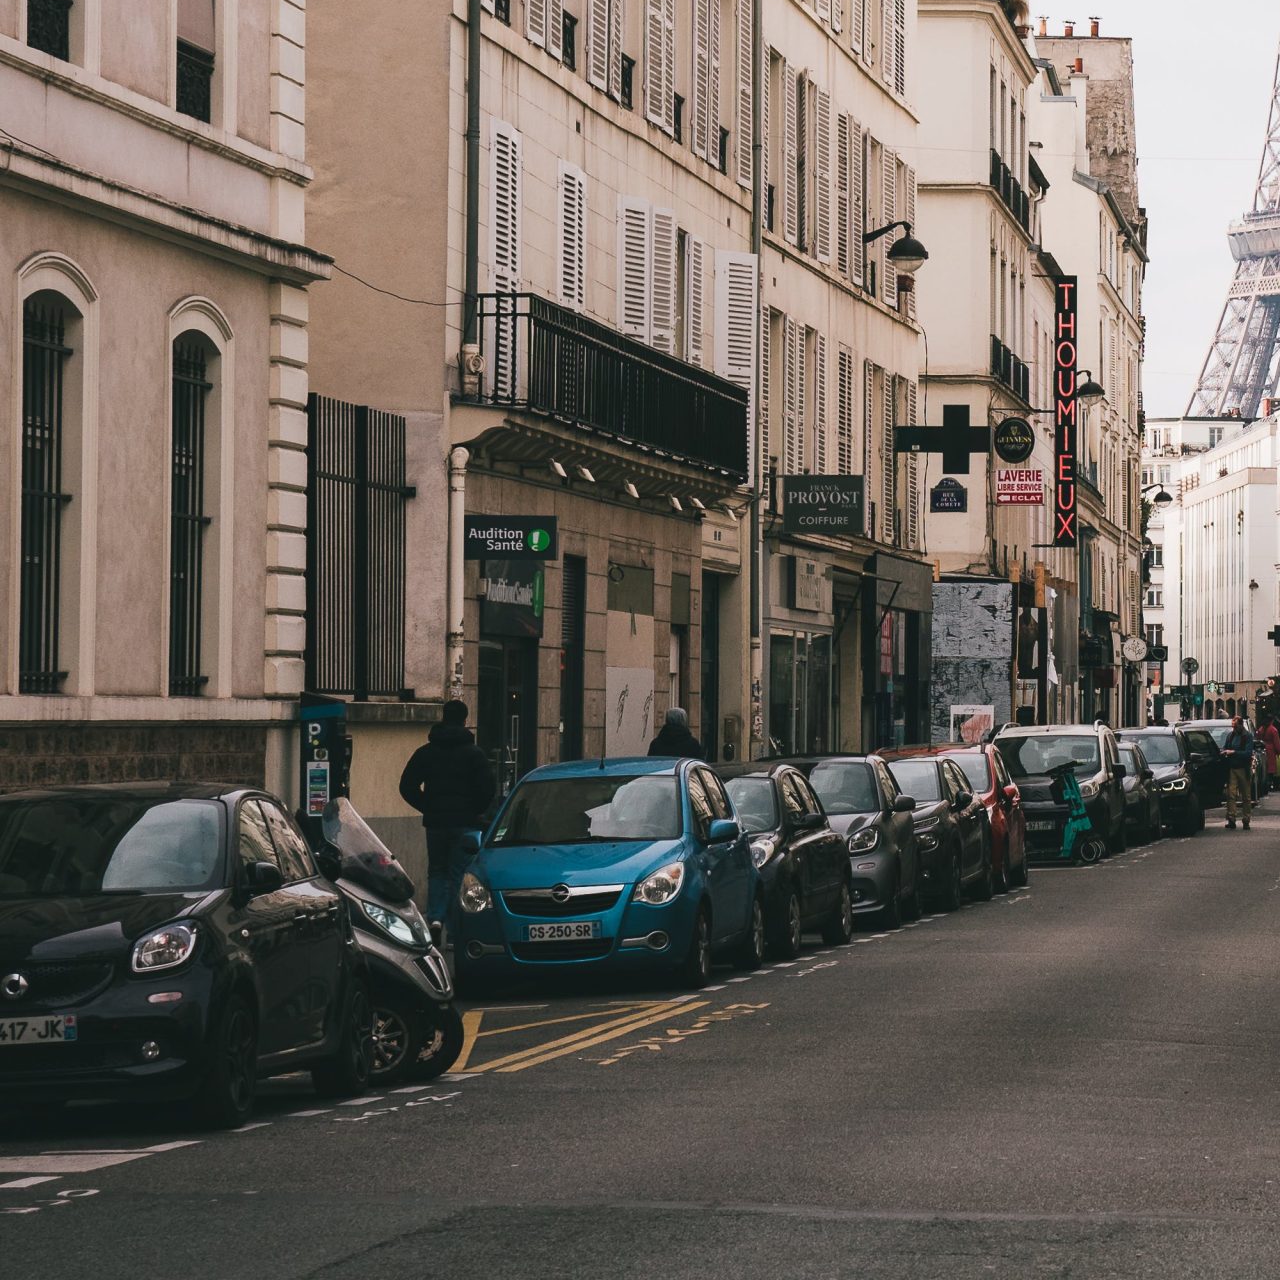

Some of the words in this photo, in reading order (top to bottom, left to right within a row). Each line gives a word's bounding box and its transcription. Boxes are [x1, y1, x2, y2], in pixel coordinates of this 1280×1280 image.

[1056, 283, 1076, 539] THOUMIEUX
[997, 470, 1042, 482] LAVERIE
[997, 483, 1015, 491] LIBRE
[1017, 483, 1042, 491] SERVICE
[788, 491, 858, 504] PROVOST
[799, 516, 849, 525] COIFFURE
[469, 528, 523, 539] Audition
[487, 539, 523, 551] Santé
[529, 924, 591, 939] CS-250-SR
